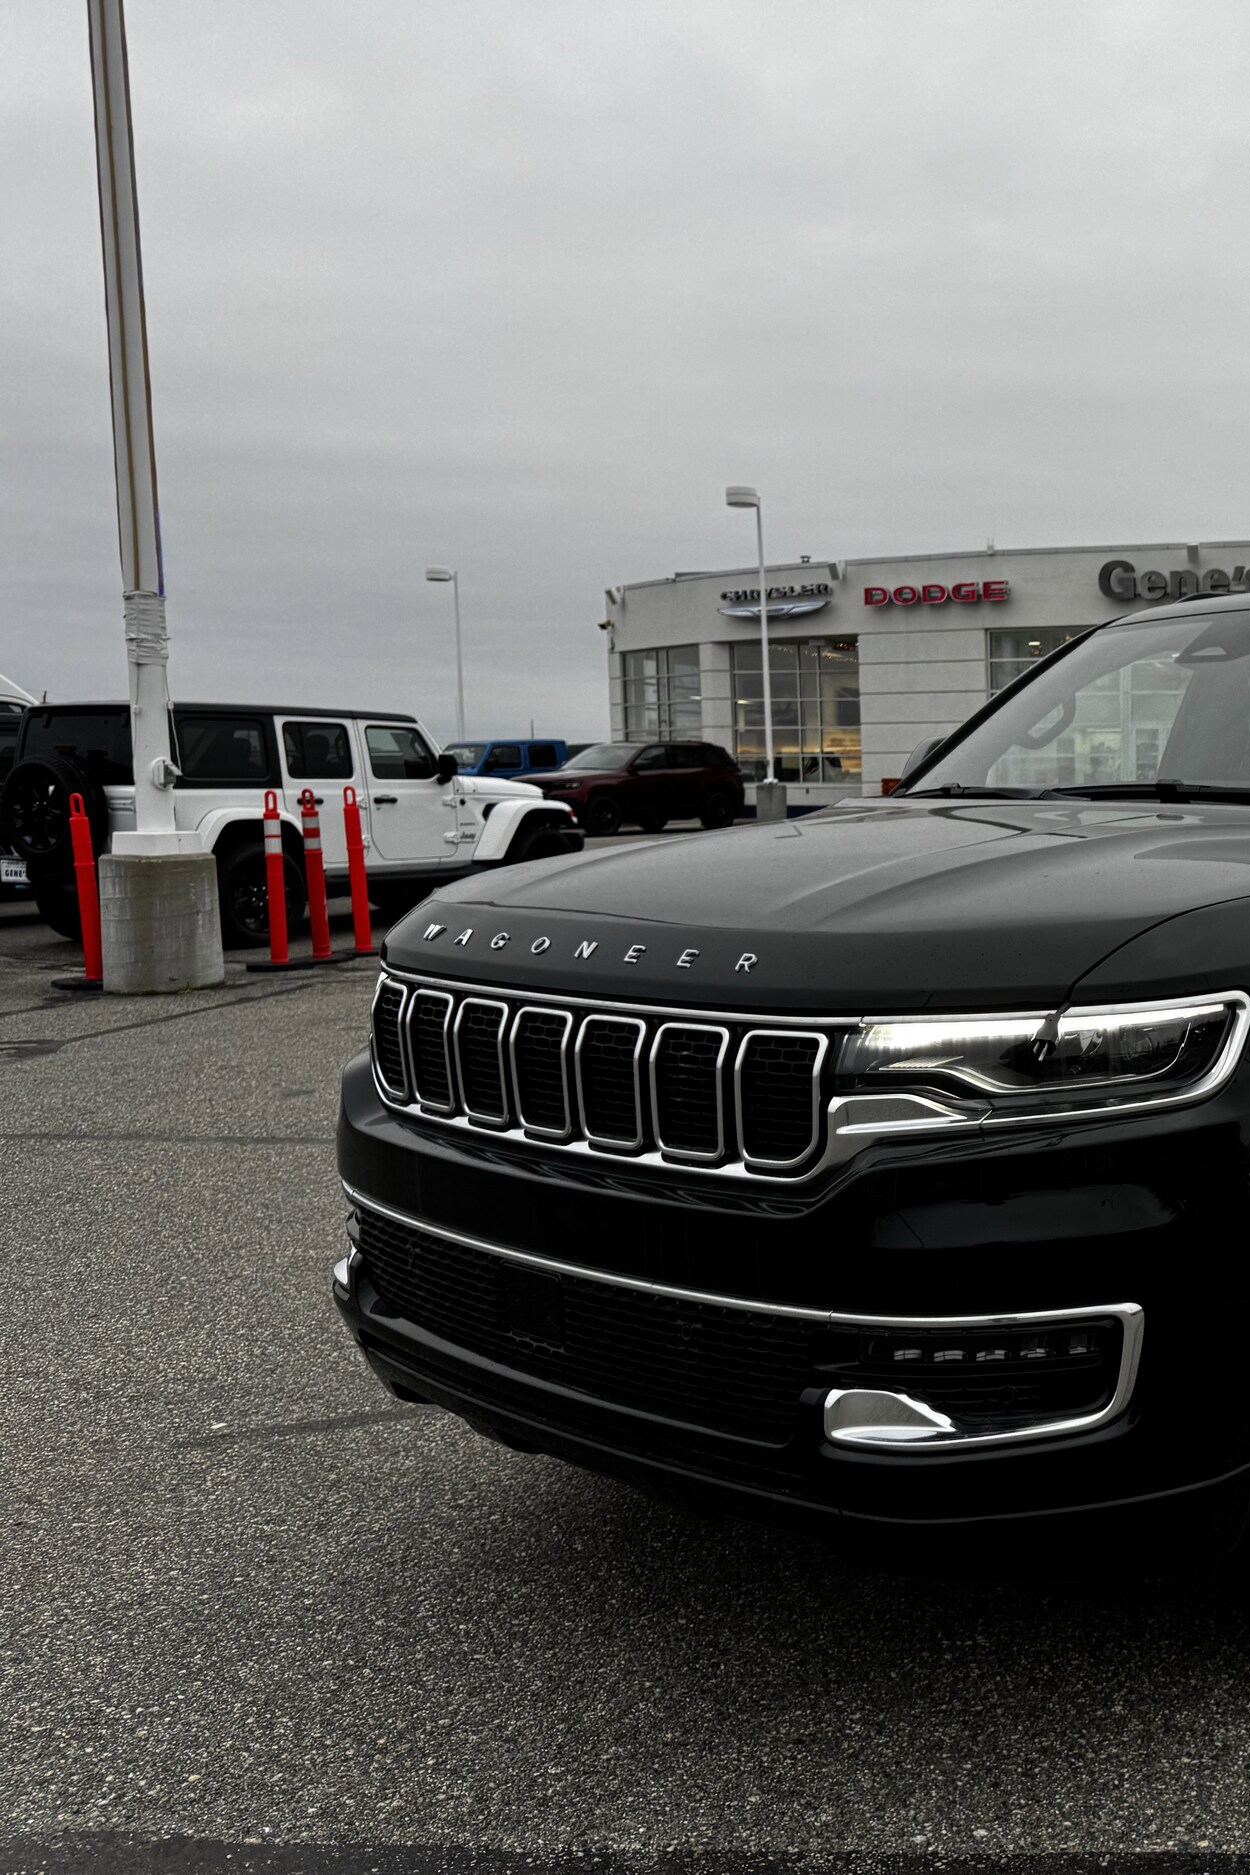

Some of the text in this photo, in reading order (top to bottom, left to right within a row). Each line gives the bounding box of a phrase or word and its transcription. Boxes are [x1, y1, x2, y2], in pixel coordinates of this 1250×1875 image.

[720, 583, 833, 600] CHRYSLER
[864, 580, 1010, 606] DODGE
[423, 923, 758, 973] WAGONEER
